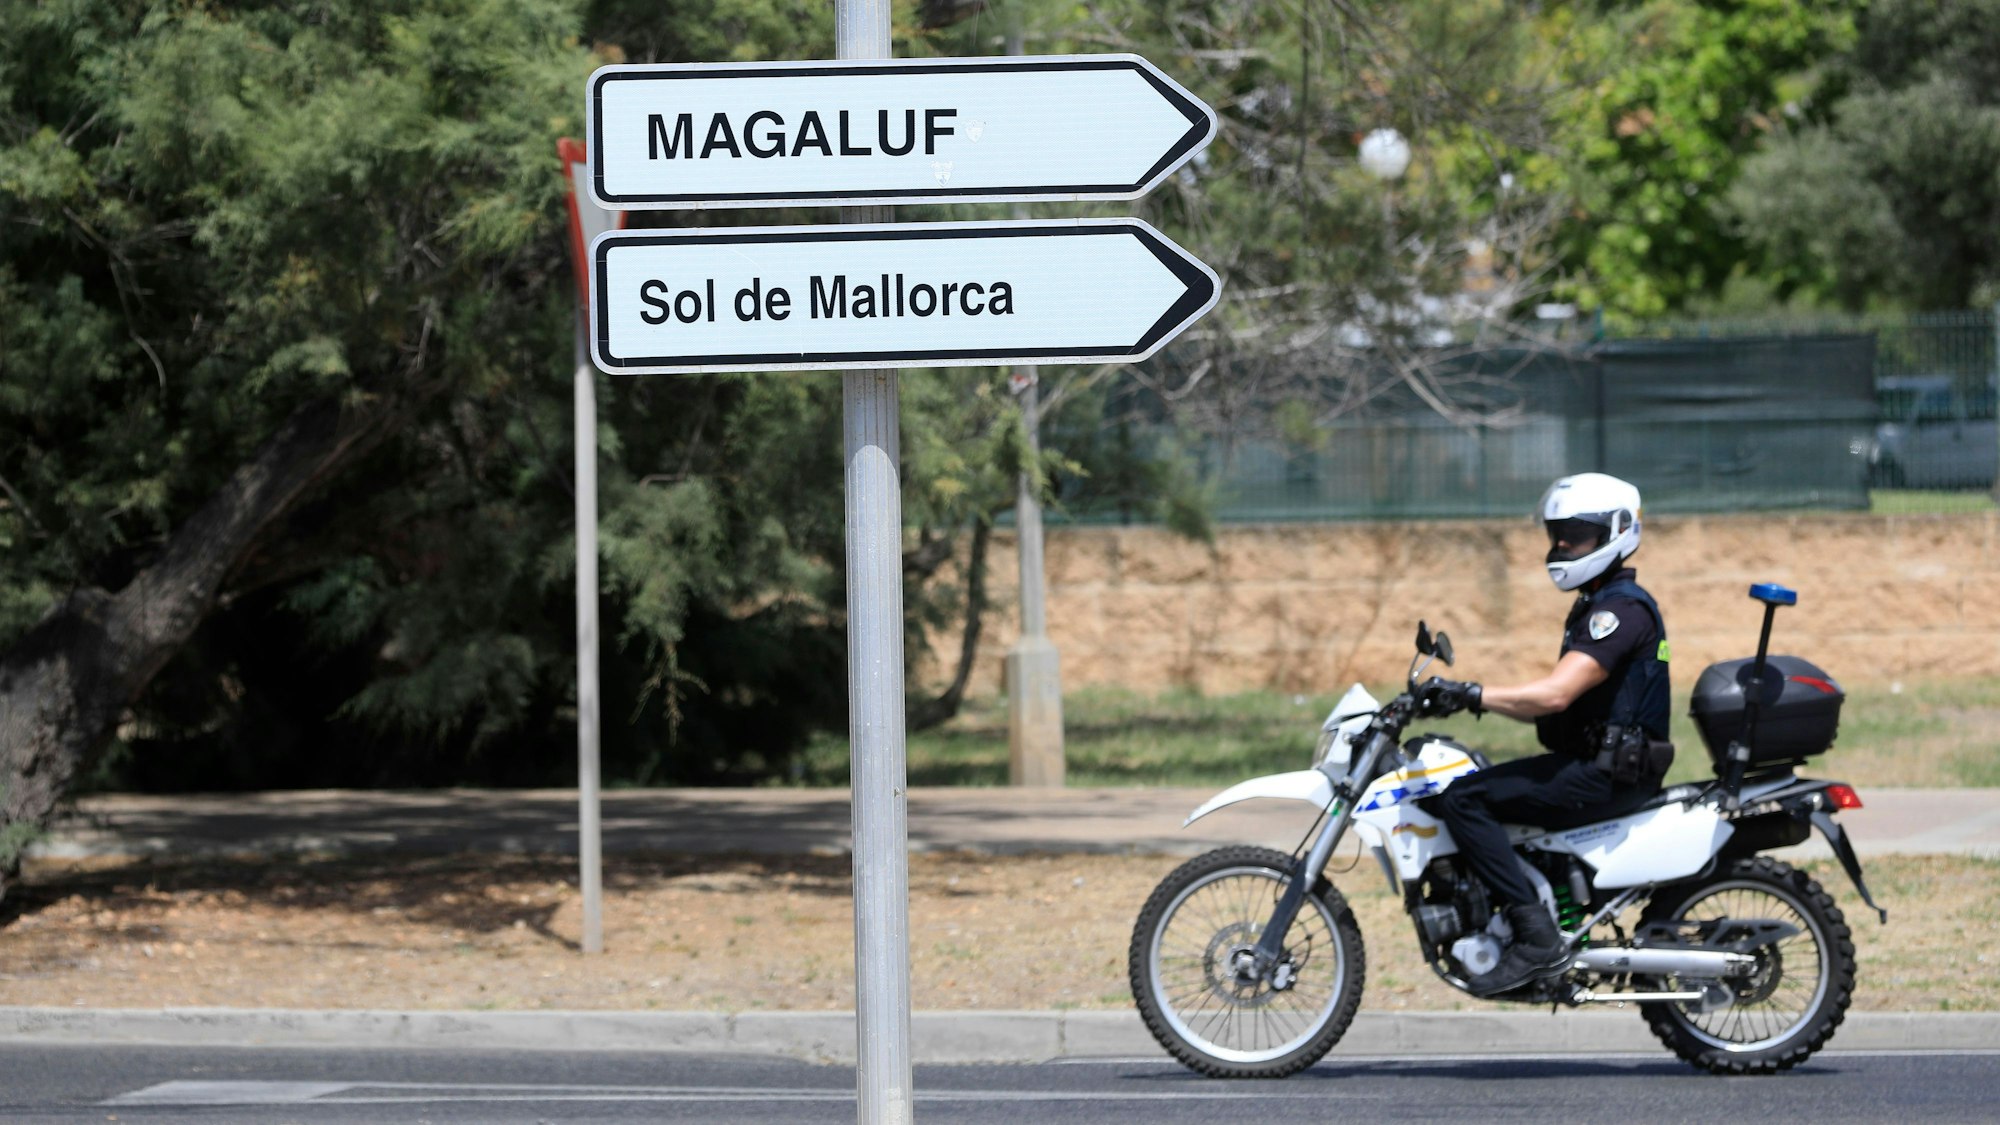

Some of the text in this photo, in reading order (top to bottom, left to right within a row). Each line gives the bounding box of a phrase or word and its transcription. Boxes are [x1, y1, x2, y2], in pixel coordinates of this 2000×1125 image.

[648, 108, 958, 160] MAGALUF
[640, 273, 1014, 325] Sol de Mallorca
